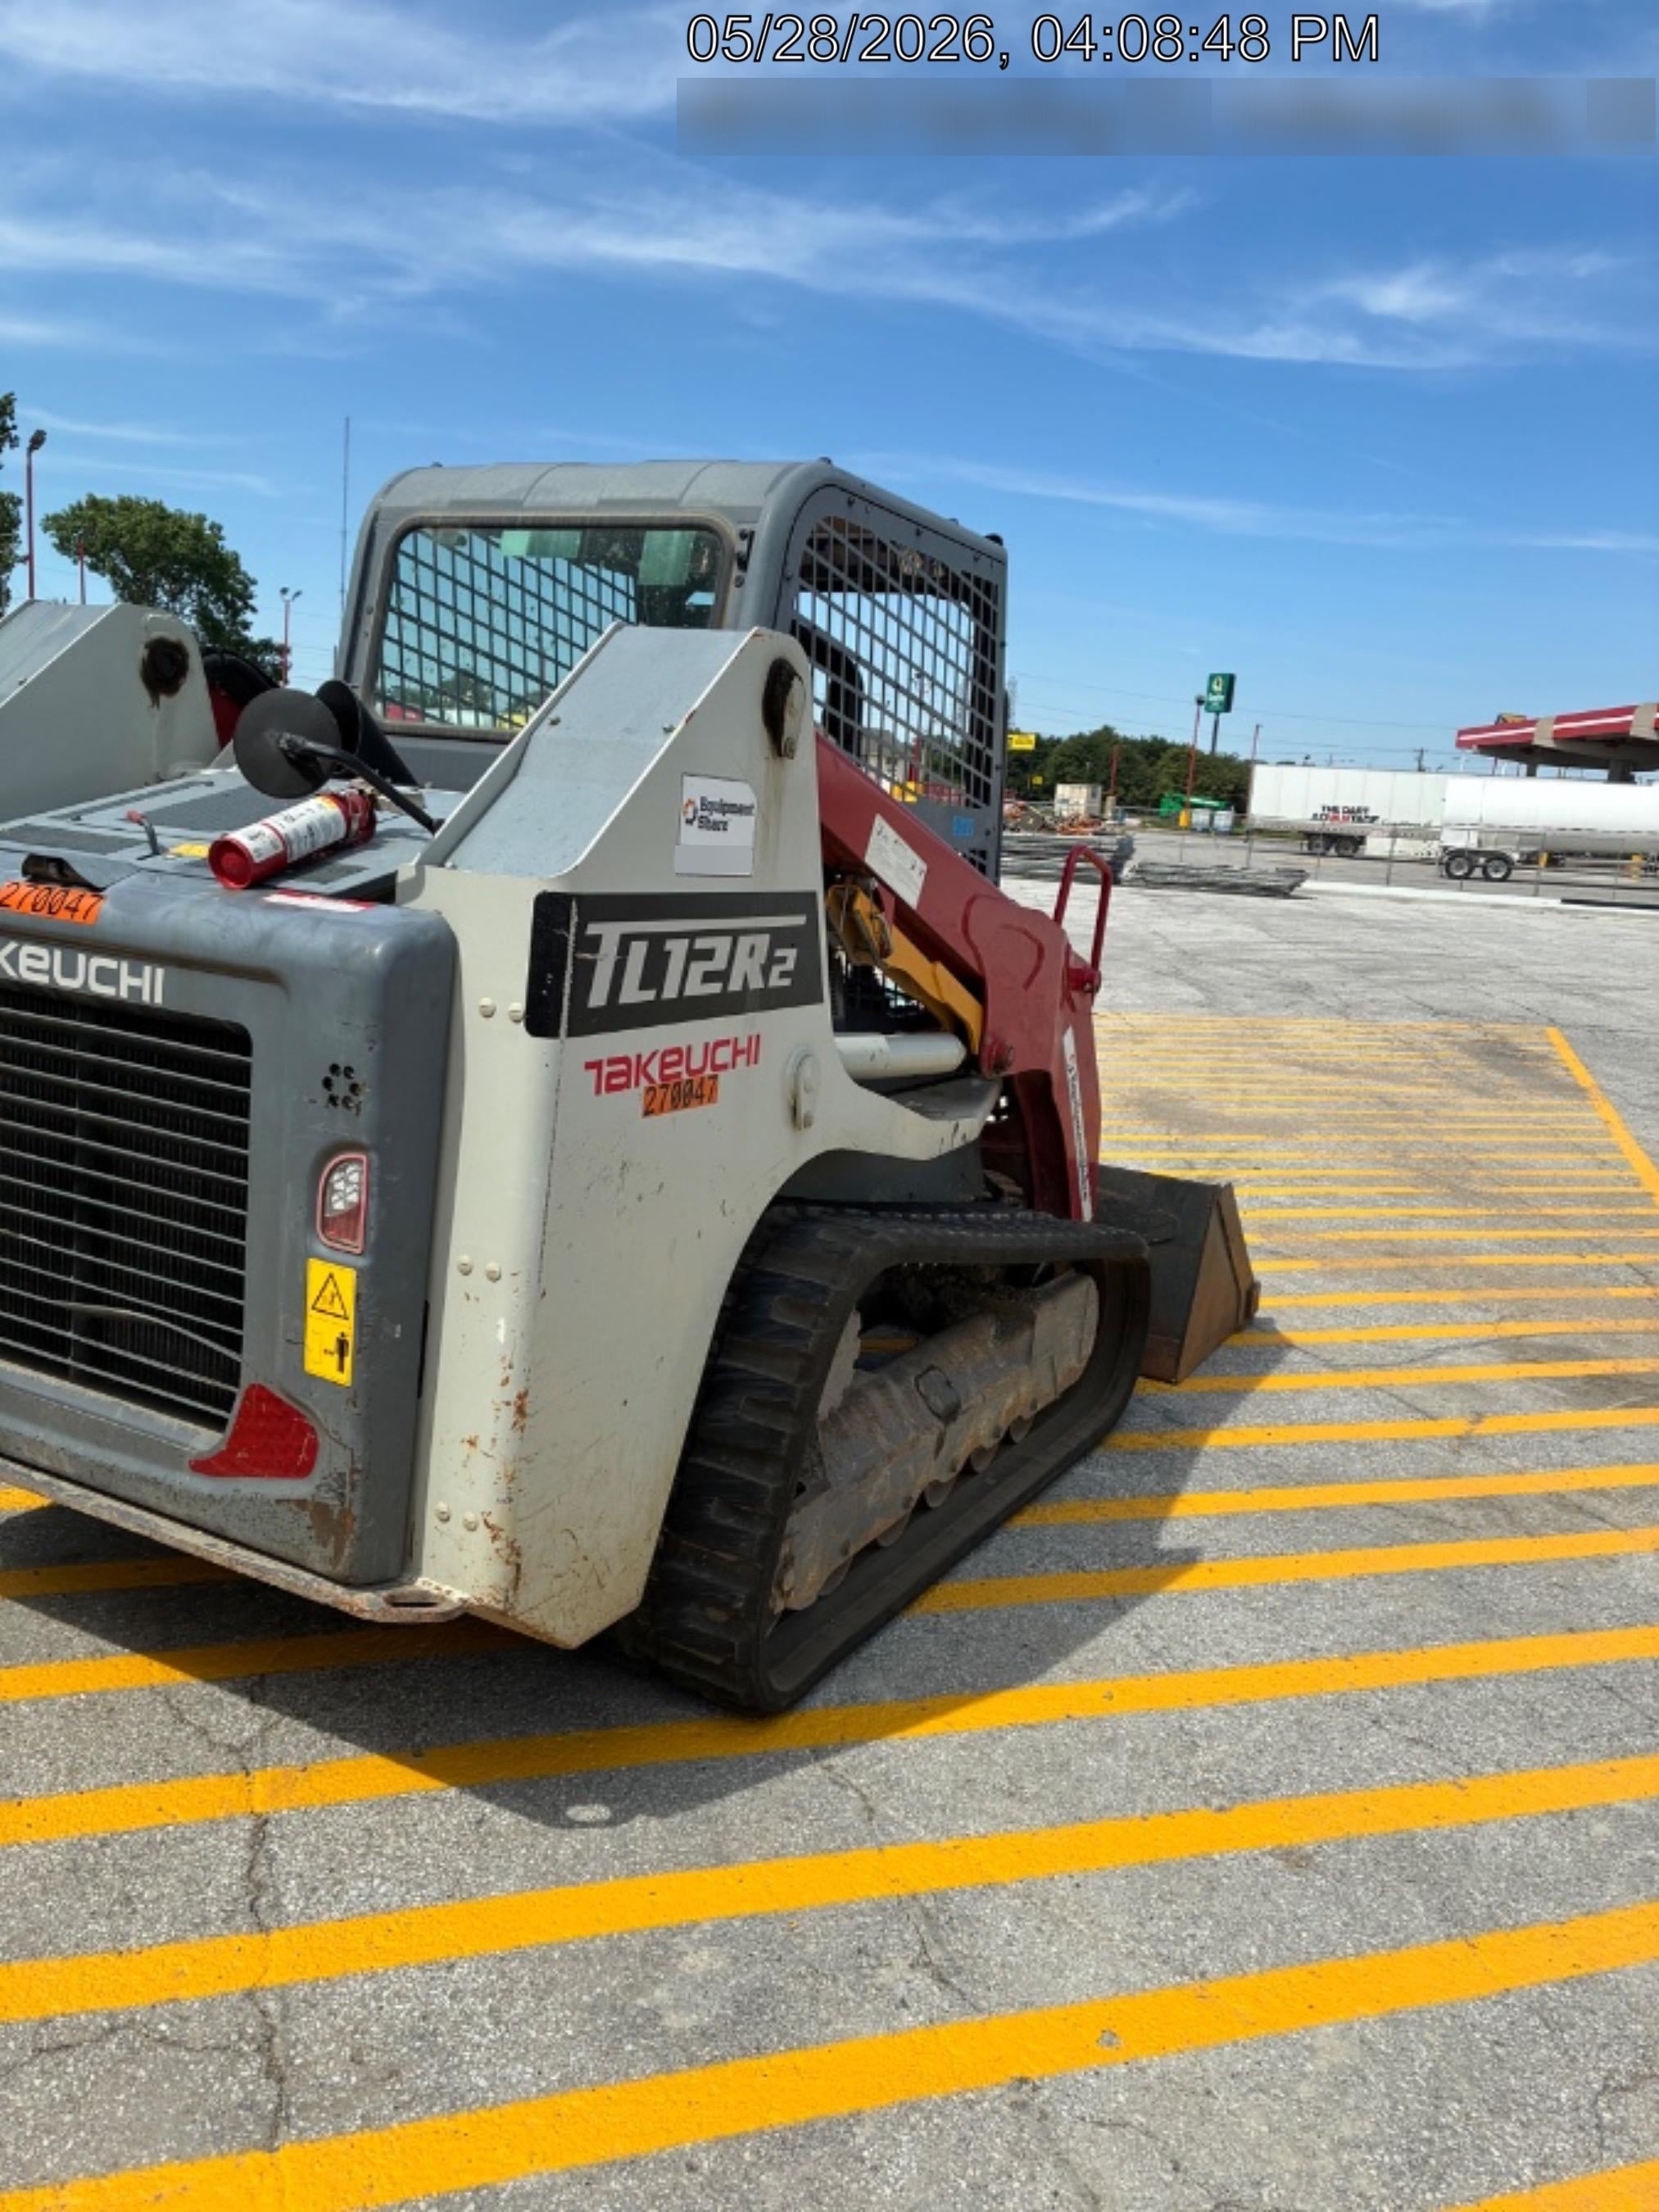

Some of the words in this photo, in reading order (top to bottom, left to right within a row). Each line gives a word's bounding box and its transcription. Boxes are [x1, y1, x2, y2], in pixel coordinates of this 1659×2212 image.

[0, 882, 106, 921] 270047
[584, 913, 807, 1009] TL12R2
[642, 1073, 719, 1117] 270047
